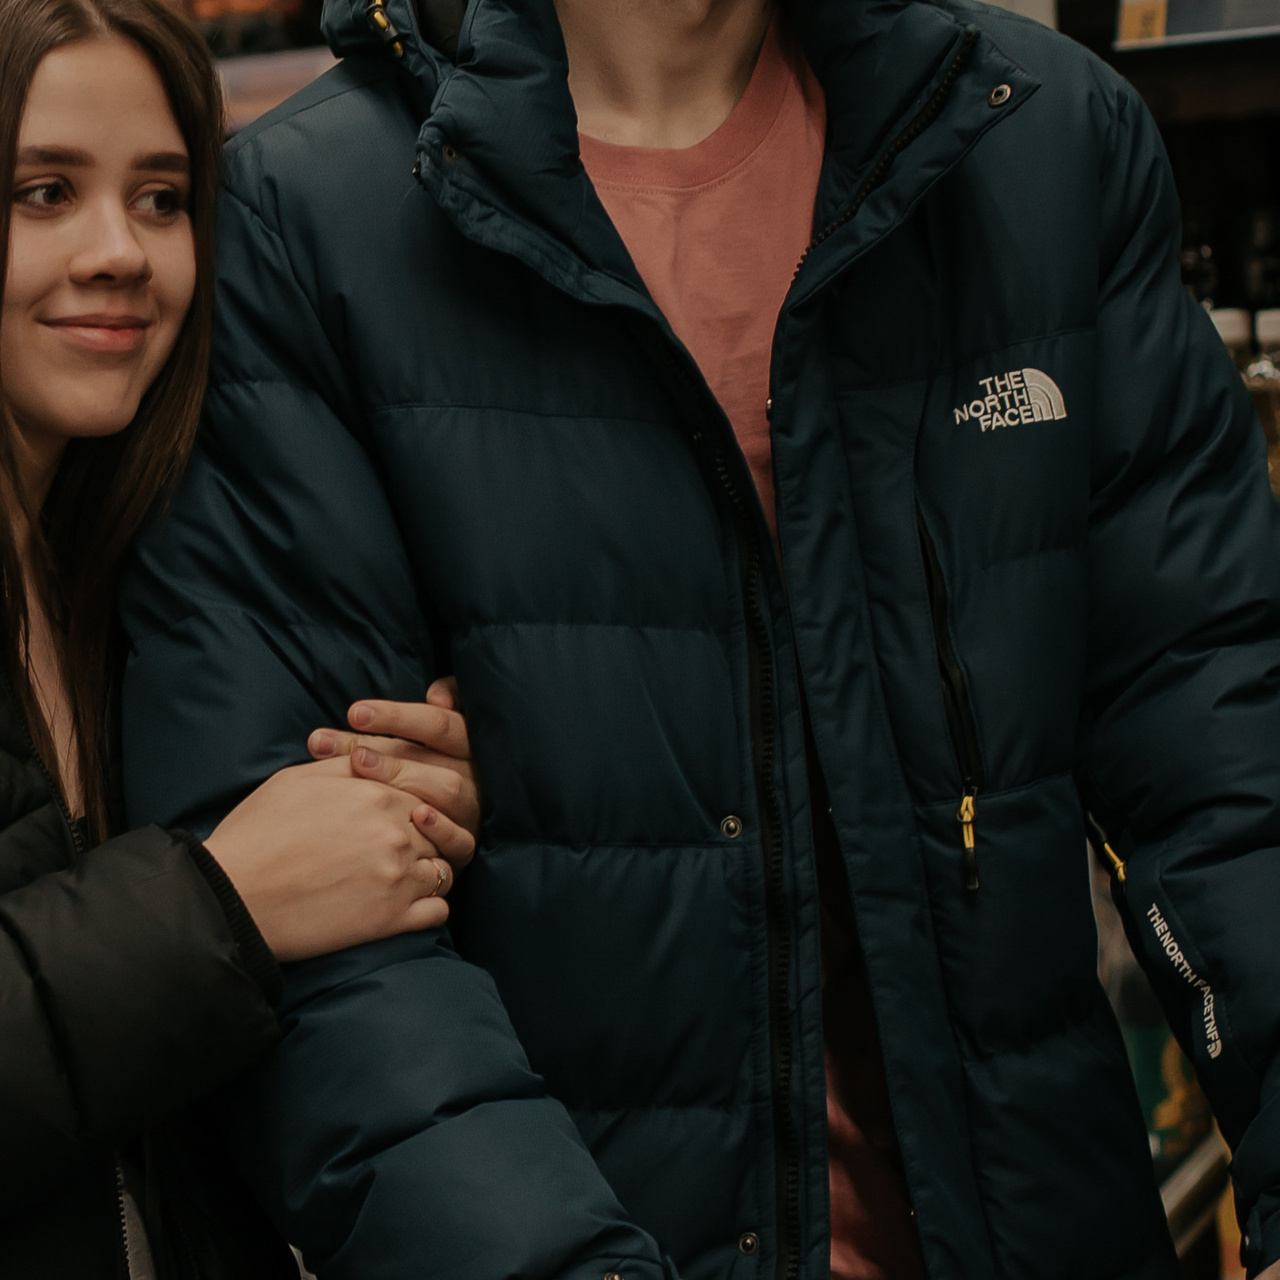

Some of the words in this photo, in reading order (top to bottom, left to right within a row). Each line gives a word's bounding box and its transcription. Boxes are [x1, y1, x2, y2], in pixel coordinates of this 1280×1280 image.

[979, 370, 1025, 395] THE
[953, 387, 1029, 425] NORTH
[979, 405, 1034, 432] FACE
